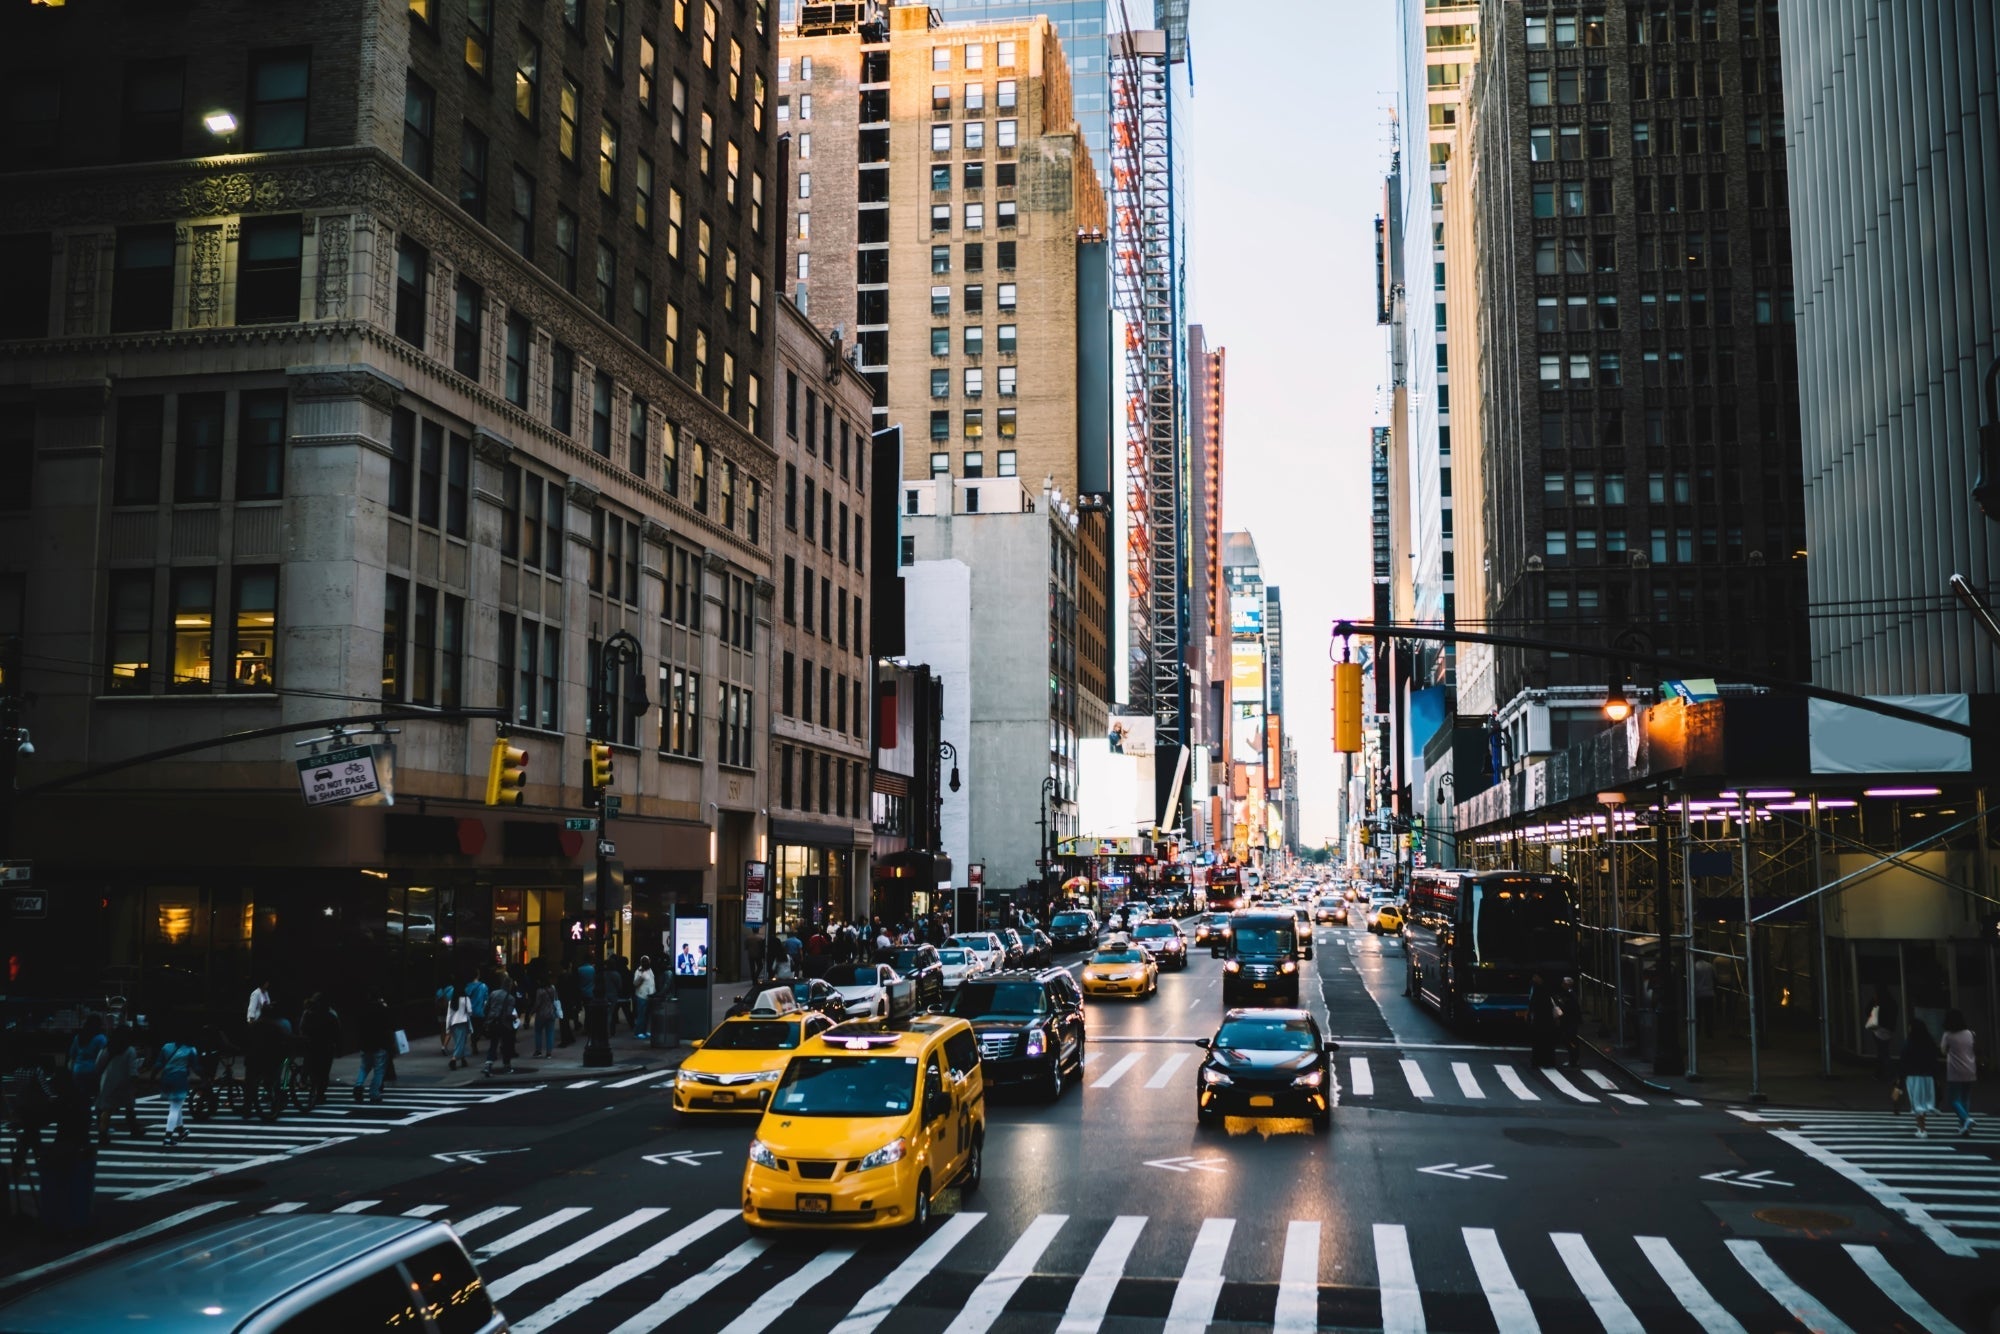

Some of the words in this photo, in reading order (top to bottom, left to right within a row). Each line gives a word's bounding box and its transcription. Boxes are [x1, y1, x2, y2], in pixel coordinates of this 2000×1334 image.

[309, 757, 329, 767] BIKE
[332, 750, 359, 762] ROUTE
[313, 782, 326, 792] DO
[327, 779, 343, 789] NOT
[345, 774, 366, 785] PASS
[319, 787, 352, 800] SHARED
[353, 781, 376, 793] LANE
[16, 898, 40, 910] WAY
